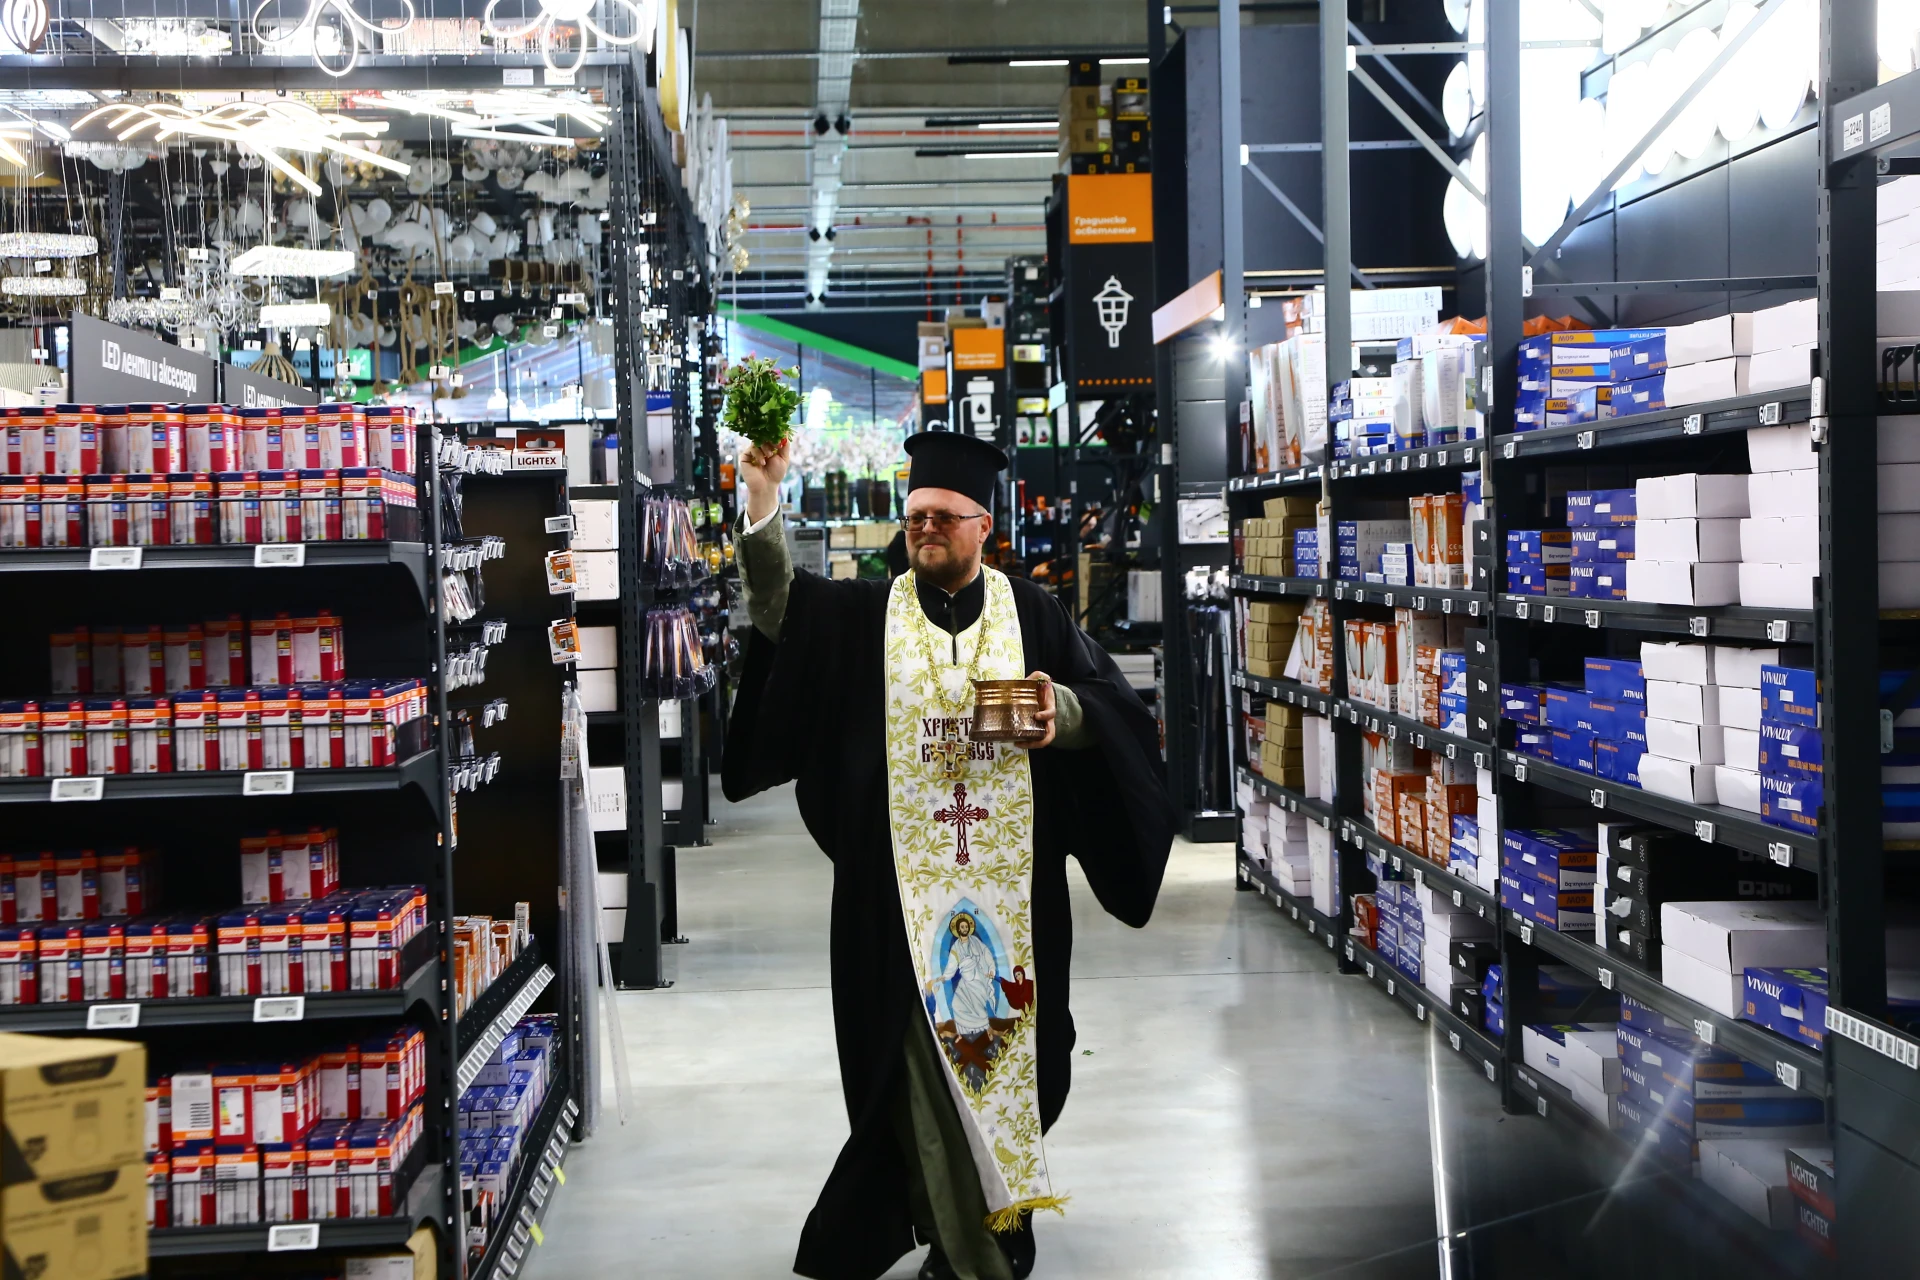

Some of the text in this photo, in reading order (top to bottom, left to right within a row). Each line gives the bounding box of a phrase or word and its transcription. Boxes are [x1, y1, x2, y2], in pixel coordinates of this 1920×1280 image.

[1075, 216, 1127, 226] Градинско
[1075, 227, 1136, 236] осветление
[1610, 346, 1632, 359] VIVALUX
[102, 339, 197, 398] LED ленти и аксесоари
[1612, 384, 1633, 396] VIVALUX
[517, 457, 557, 466] LIGHTEX
[1567, 496, 1592, 506] VIVALUX
[1572, 531, 1597, 542] VIVALUX
[1570, 567, 1594, 578] VIVALUX
[1762, 671, 1788, 687] VIVALUX
[1762, 725, 1793, 742] VIVALUX
[1762, 776, 1795, 796] VIVALUX
[1504, 838, 1523, 851] VIVALUX
[1501, 875, 1521, 890] VIVALUX
[1623, 1009, 1632, 1021] LED
[1617, 1028, 1643, 1049] VIVALUX
[1622, 1064, 1646, 1087] VIVALUX
[1617, 1101, 1641, 1123] VIVALUX
[1790, 1160, 1818, 1193] LIGHTEX
[1800, 1205, 1829, 1239] LIGHTEX
